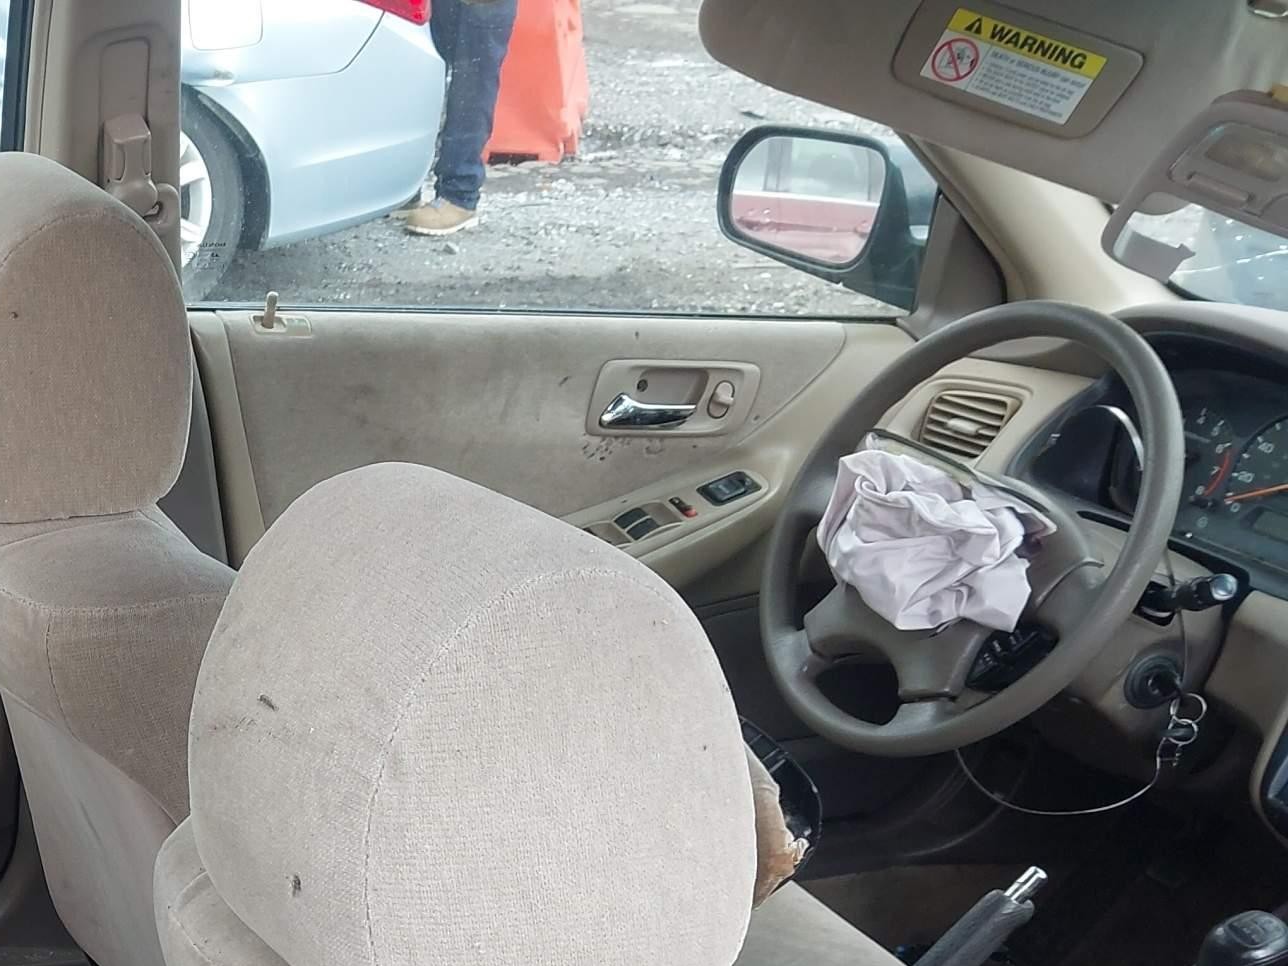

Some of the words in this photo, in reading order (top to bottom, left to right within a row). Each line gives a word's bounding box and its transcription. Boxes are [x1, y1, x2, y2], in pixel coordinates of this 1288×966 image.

[989, 24, 1087, 69] WARNING
[1258, 442, 1274, 454] 40
[1238, 471, 1254, 483] 20
